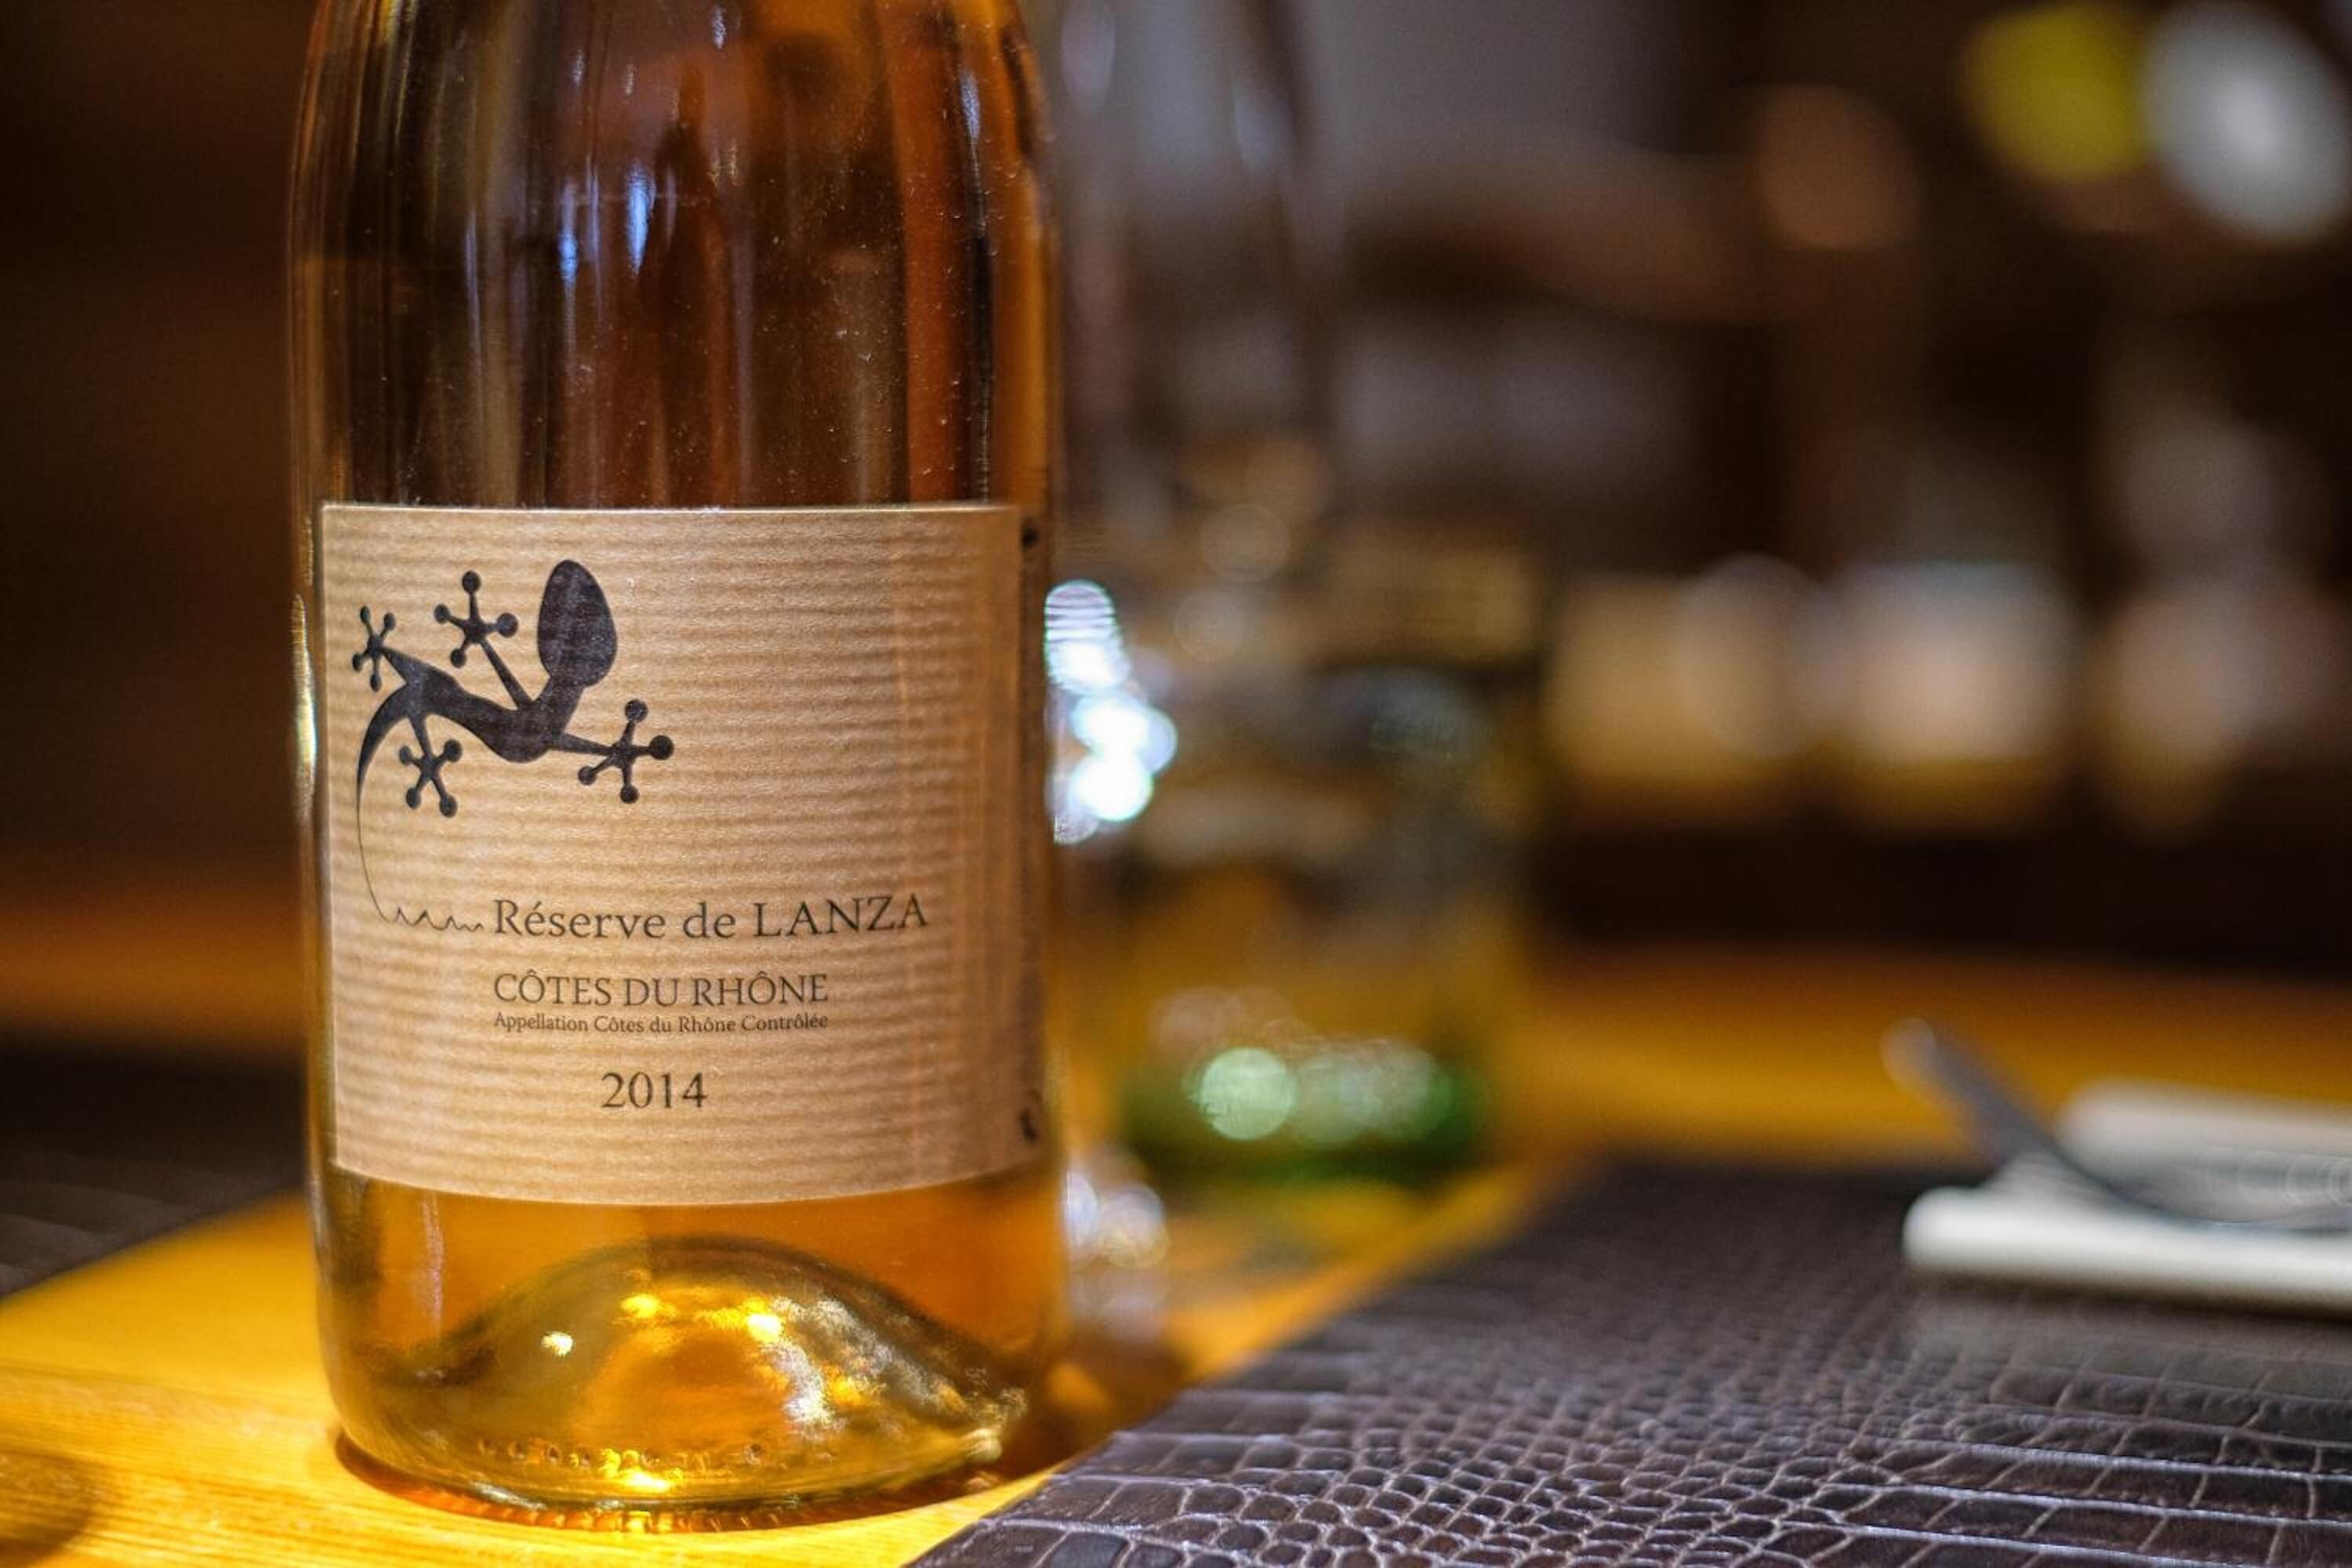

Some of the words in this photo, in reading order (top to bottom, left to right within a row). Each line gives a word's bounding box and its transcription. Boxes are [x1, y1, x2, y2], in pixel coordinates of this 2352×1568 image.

[494, 898, 666, 939] Réserve
[682, 902, 736, 939] de
[753, 892, 928, 938] LANZA
[494, 970, 612, 1006] CÔTES
[622, 977, 680, 1007] DU
[691, 971, 829, 1006] RHÔNE
[494, 1011, 589, 1033] Appellation
[593, 1015, 644, 1033] Côtes
[649, 1016, 672, 1033] du
[678, 1016, 735, 1033] Rhône
[741, 1013, 829, 1032] Contrôlée
[601, 1073, 707, 1109] 2014
